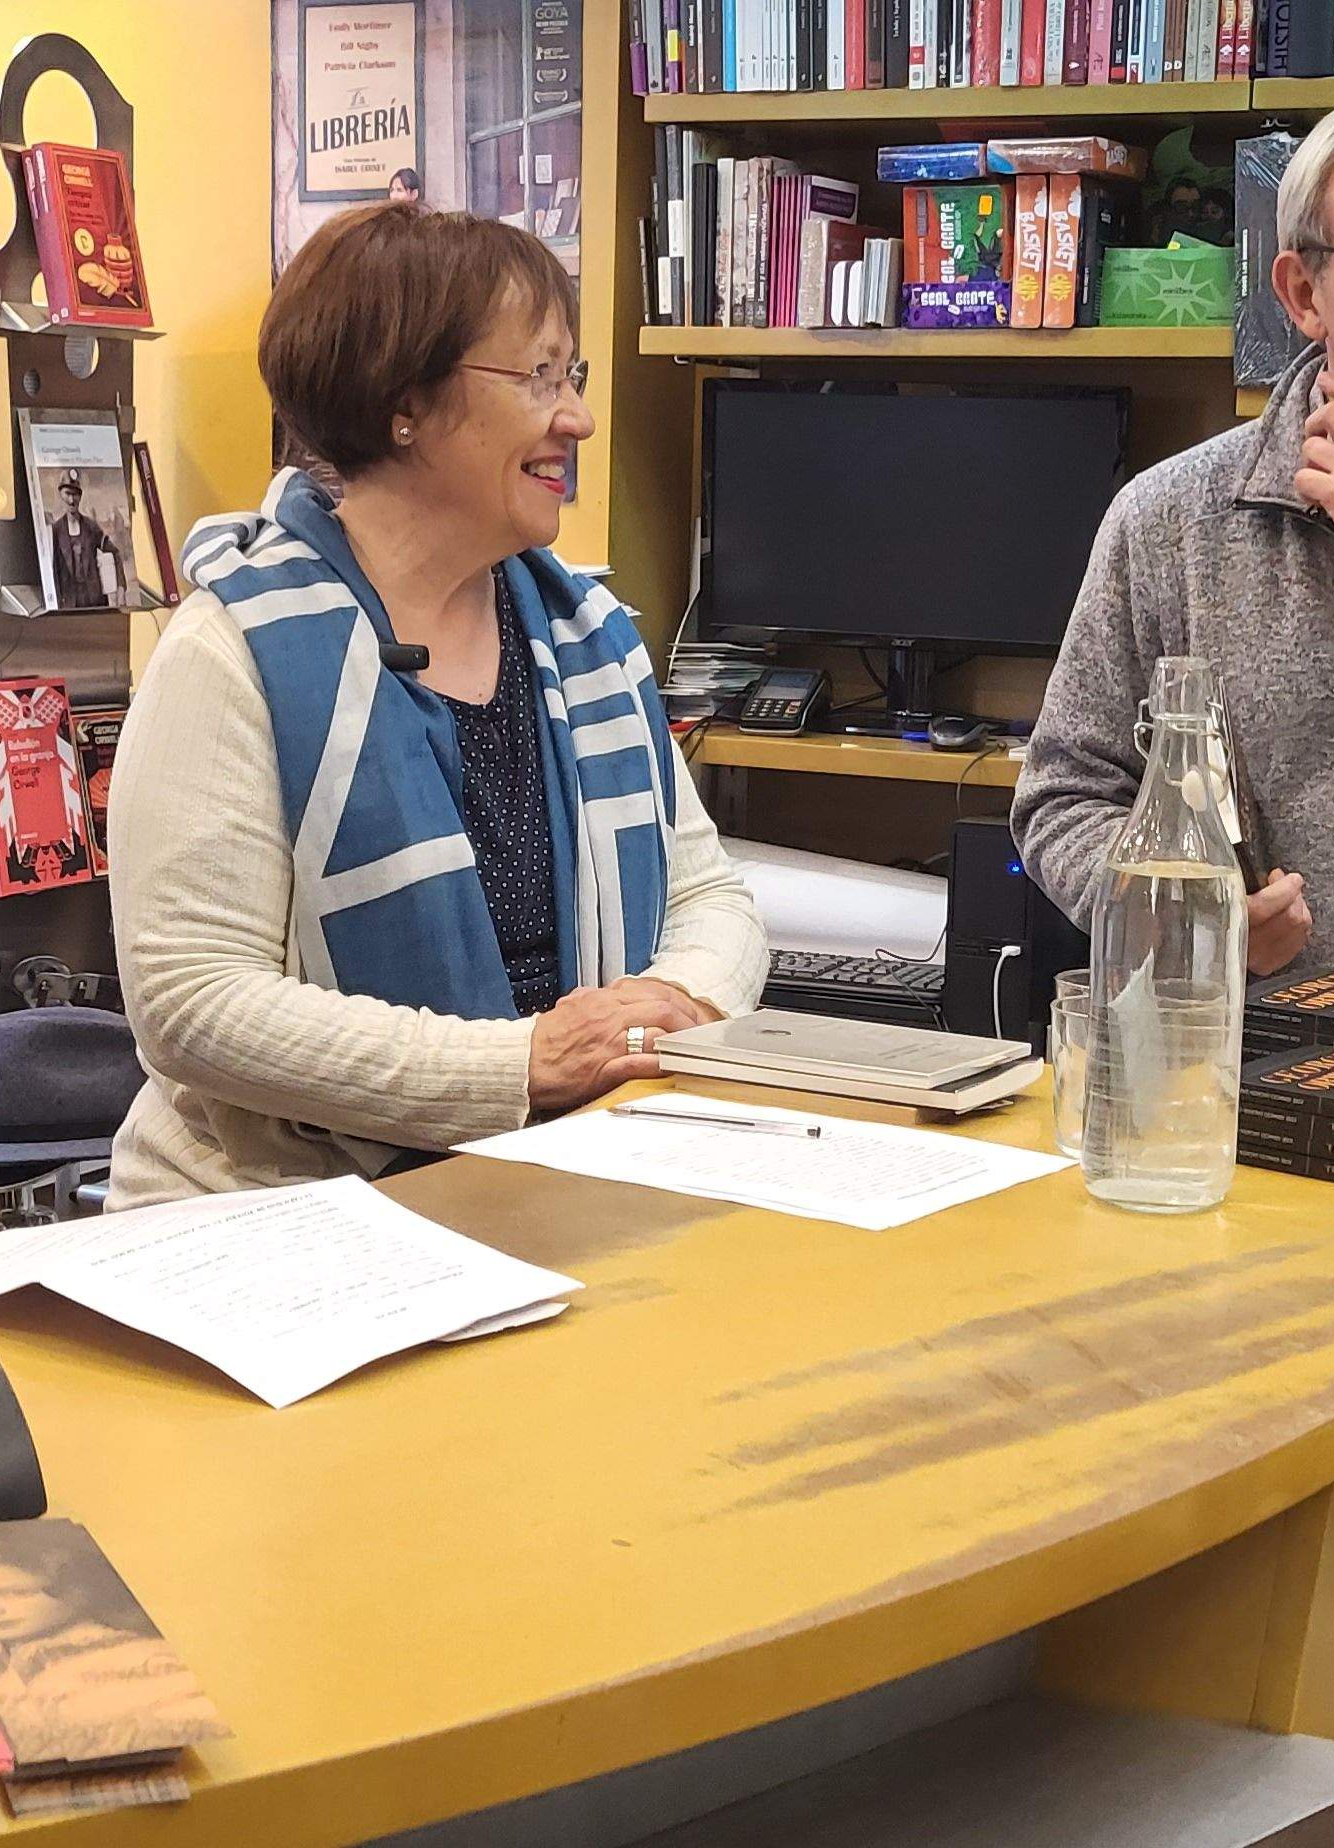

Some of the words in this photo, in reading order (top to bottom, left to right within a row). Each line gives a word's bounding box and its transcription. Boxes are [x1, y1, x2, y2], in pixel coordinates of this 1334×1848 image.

[535, 8, 569, 20] GOYA
[310, 98, 411, 153] LIBRERÍA
[1017, 211, 1040, 272] BASKET
[1050, 210, 1074, 273] BASKET
